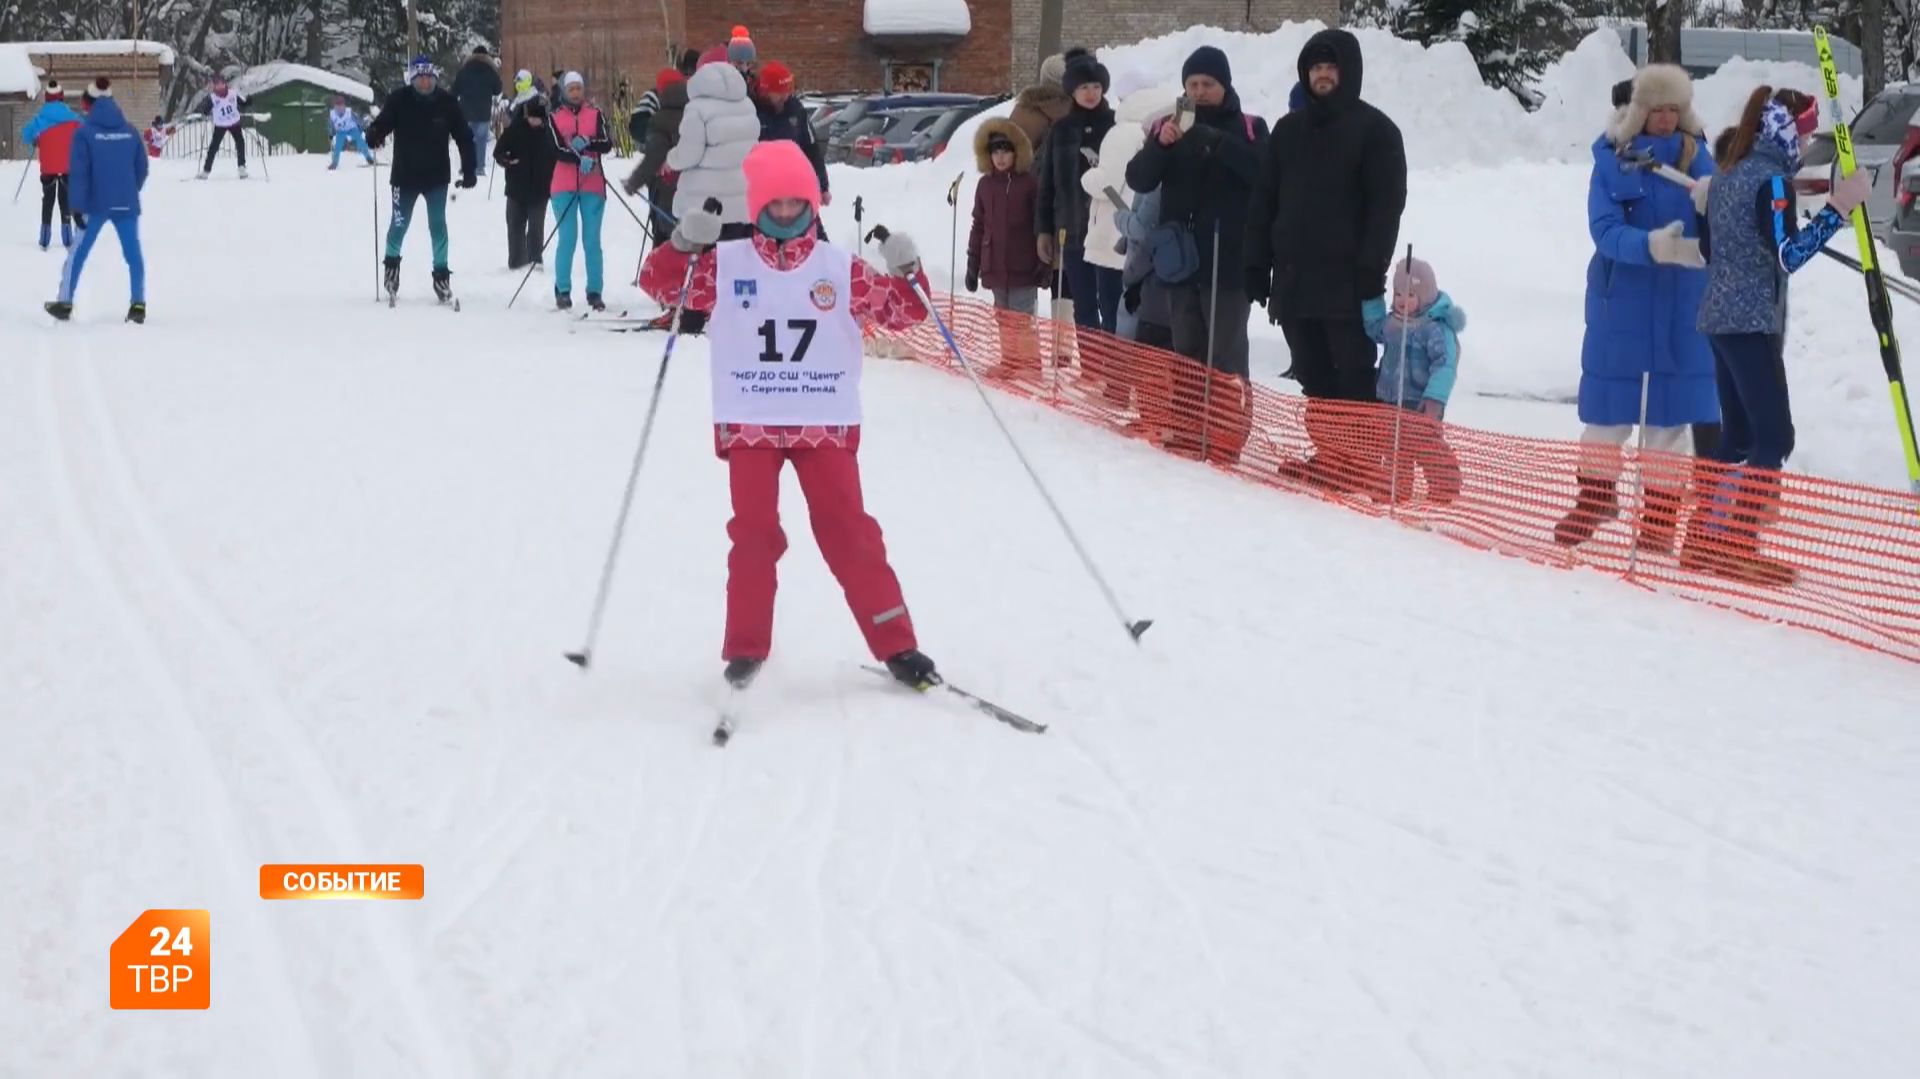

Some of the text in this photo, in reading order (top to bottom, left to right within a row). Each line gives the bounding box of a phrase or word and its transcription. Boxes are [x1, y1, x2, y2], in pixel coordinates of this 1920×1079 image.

[1824, 66, 1851, 155] FISER
[757, 319, 818, 362] 17
[751, 385, 798, 394] Сергиев
[801, 385, 837, 394] Посад
[759, 371, 776, 381] ДО
[778, 371, 799, 381] СШ
[802, 371, 846, 382] "Центр"
